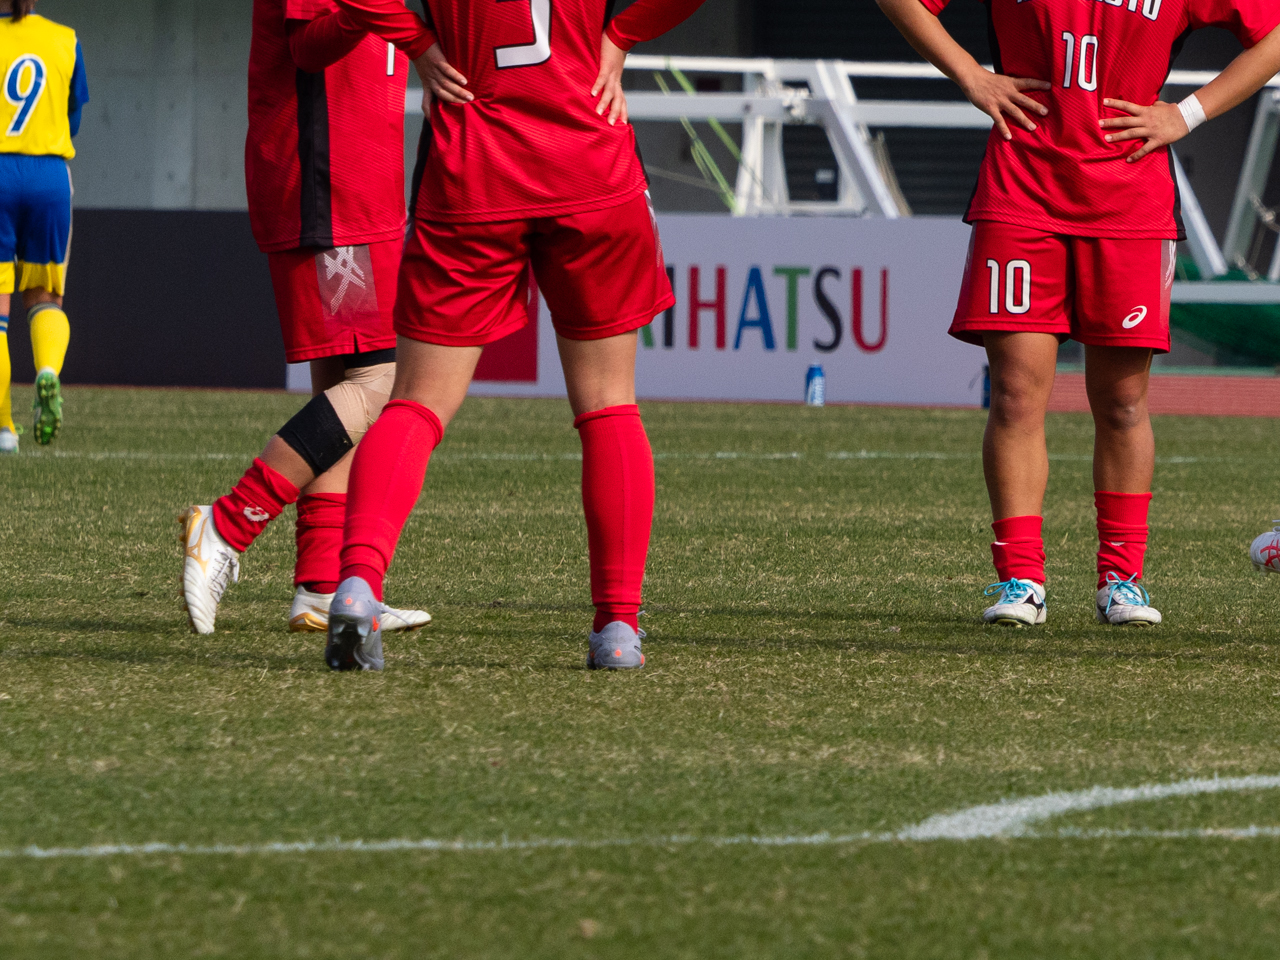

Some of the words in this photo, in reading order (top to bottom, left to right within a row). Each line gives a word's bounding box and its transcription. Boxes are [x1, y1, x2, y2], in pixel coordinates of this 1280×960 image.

[4, 53, 47, 136] 9
[1062, 31, 1098, 92] 10
[640, 262, 889, 354] IHATSU
[986, 258, 1031, 314] 10
